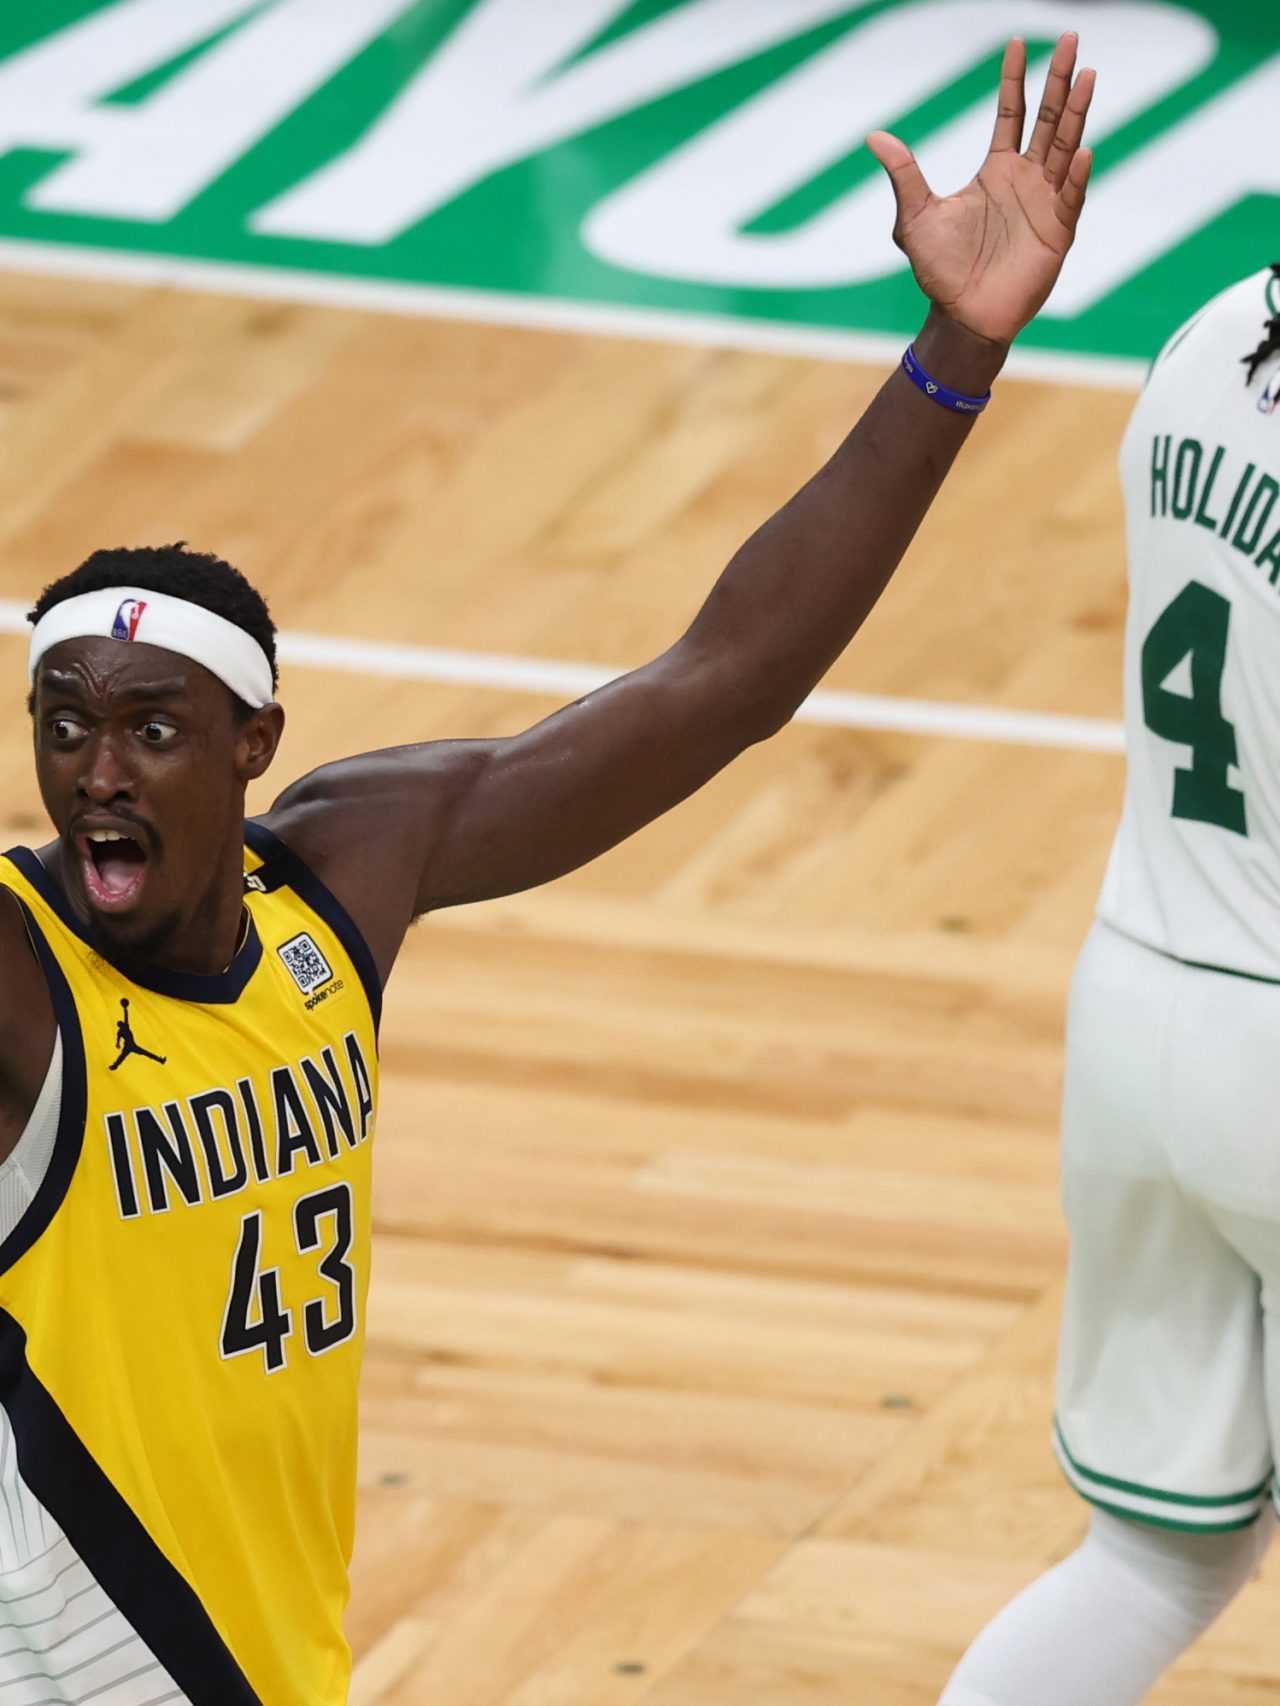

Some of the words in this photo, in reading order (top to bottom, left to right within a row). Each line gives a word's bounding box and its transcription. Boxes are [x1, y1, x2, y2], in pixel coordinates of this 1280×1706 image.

[1141, 579, 1249, 838] 4
[304, 979, 344, 1012] spokenote
[104, 1031, 374, 1219] INDIANA
[220, 1183, 357, 1375] 43
